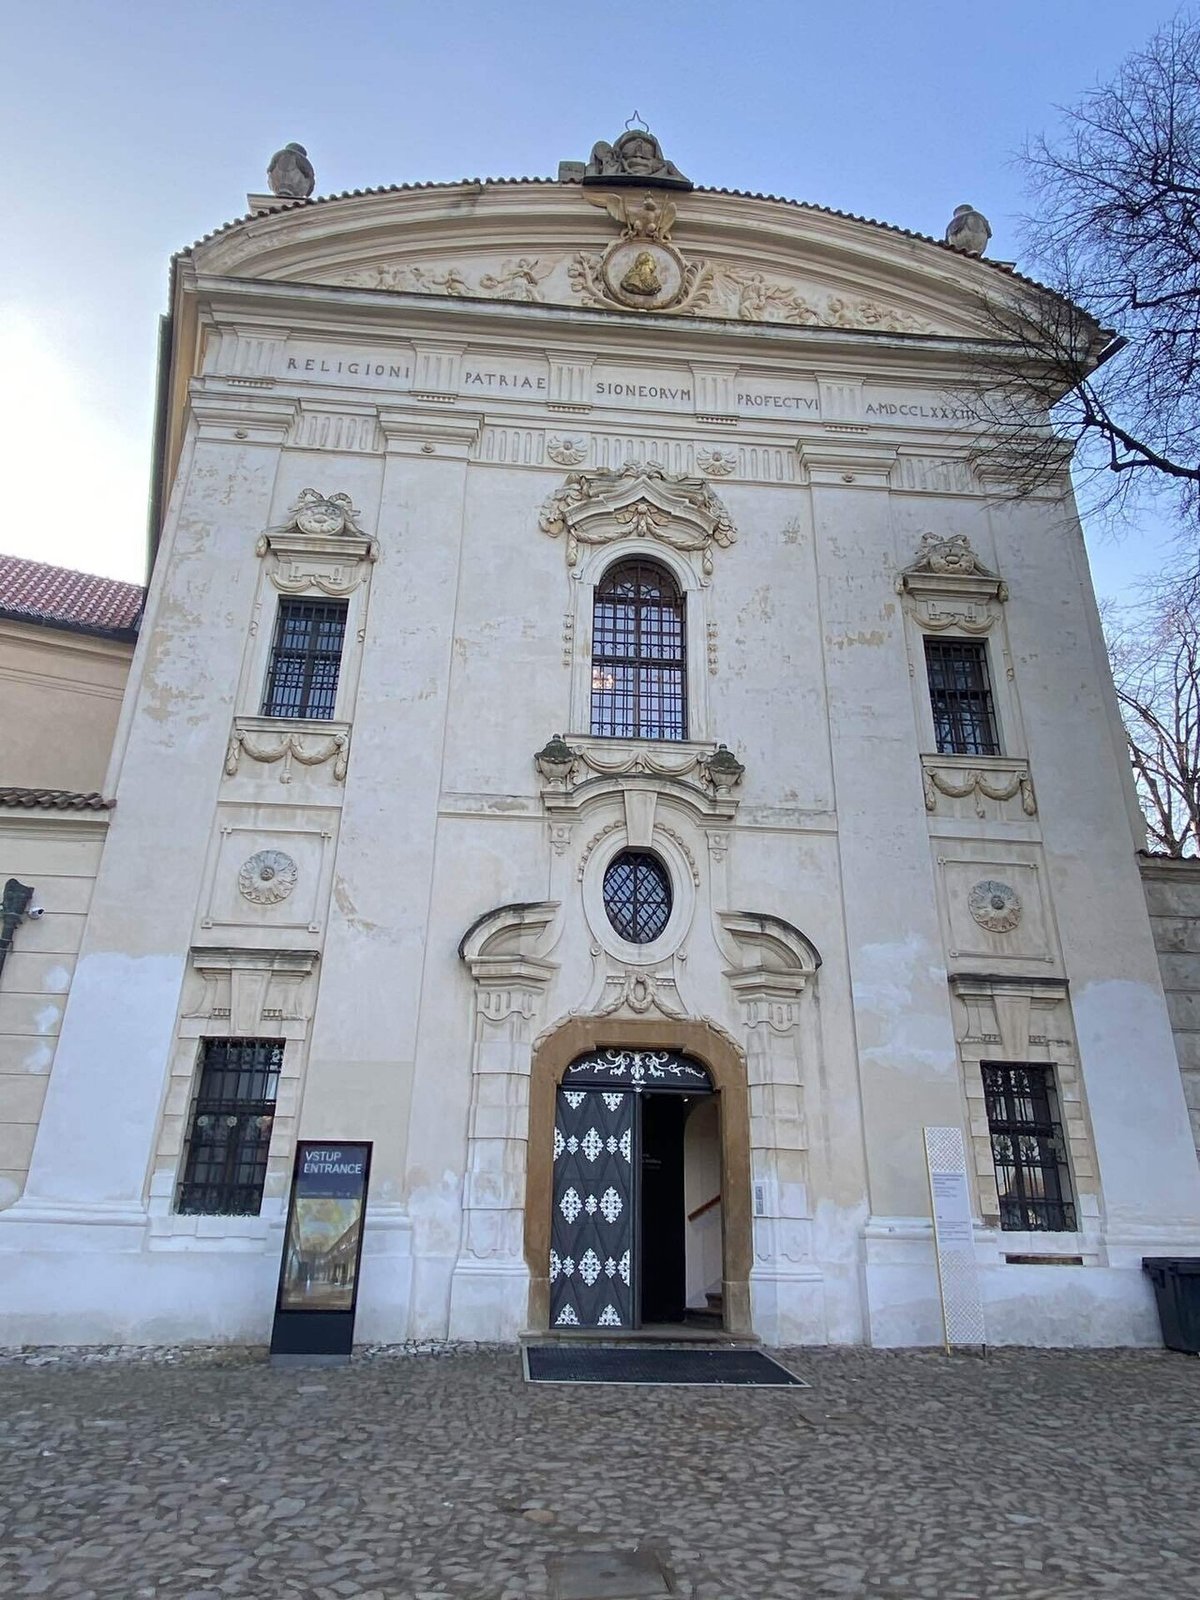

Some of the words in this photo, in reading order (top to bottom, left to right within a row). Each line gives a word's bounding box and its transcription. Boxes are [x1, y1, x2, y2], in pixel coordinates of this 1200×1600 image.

[287, 356, 409, 379] RELIGIONI
[465, 370, 546, 389] PATRIAE
[596, 383, 692, 402] SIONEORVM
[737, 393, 819, 411] PROFECTVI
[305, 1151, 342, 1161] VSTUP
[304, 1163, 362, 1174] ENTRANCE
